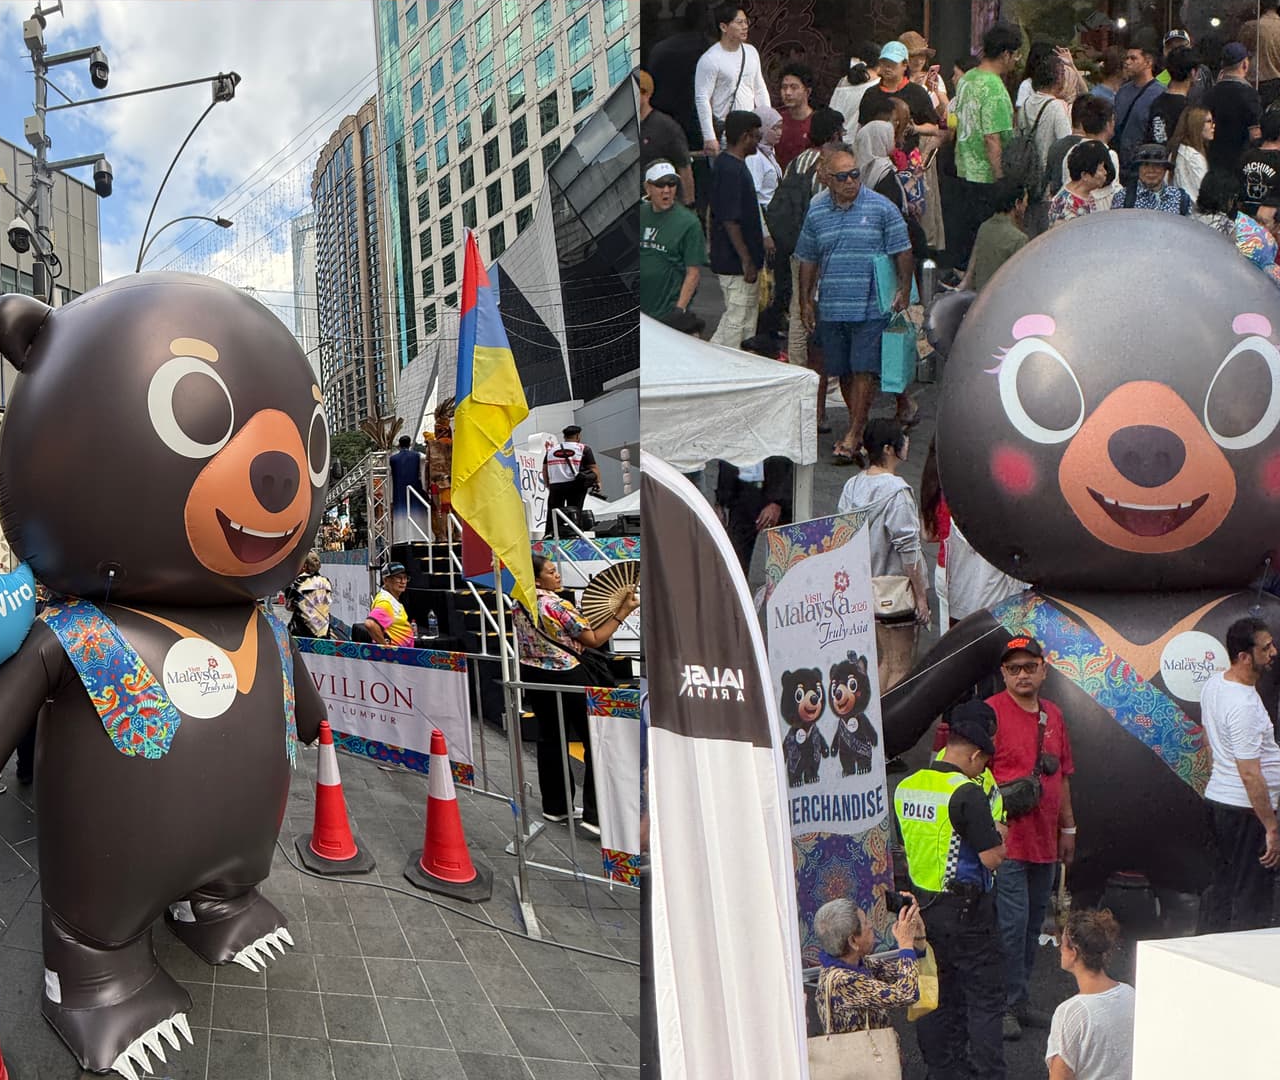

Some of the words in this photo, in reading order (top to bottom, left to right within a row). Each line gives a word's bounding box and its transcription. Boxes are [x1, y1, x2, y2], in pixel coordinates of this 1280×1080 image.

[520, 454, 536, 469] Visit
[805, 593, 822, 604] Visit
[774, 599, 850, 630] Malaysia
[850, 601, 868, 613] 2026
[818, 621, 847, 650] Truly
[848, 623, 869, 636] Asia
[1163, 658, 1214, 673] Malaysia
[167, 668, 220, 688] Malaysia
[200, 681, 221, 697] Truly
[342, 702, 397, 725] LUMPUR
[903, 802, 935, 819] POLIS
